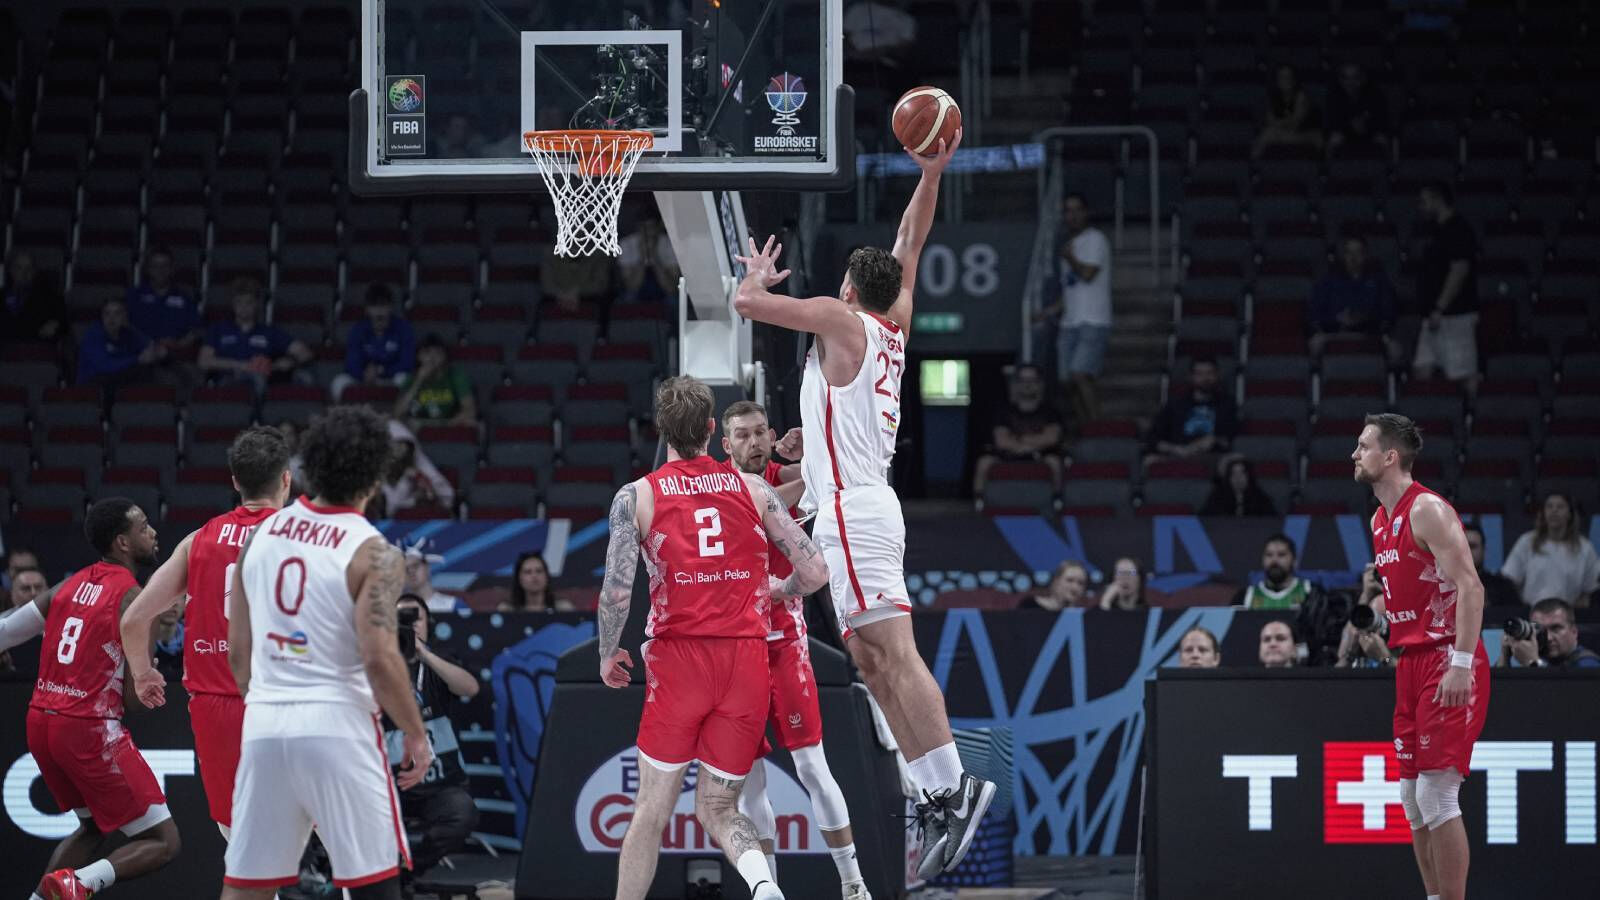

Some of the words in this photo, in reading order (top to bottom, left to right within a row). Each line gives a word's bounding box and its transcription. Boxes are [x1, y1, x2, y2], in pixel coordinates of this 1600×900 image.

[393, 121, 418, 134] FIBA
[755, 136, 817, 148] EUROBASKET
[659, 472, 741, 496] BALCEROWSKI
[268, 514, 347, 549] LARKIN
[694, 507, 724, 557] 2
[275, 556, 306, 616] 0
[697, 571, 722, 583] Bank
[724, 569, 750, 581] Pekao
[57, 616, 84, 665] 8
[1222, 755, 1297, 831] T
